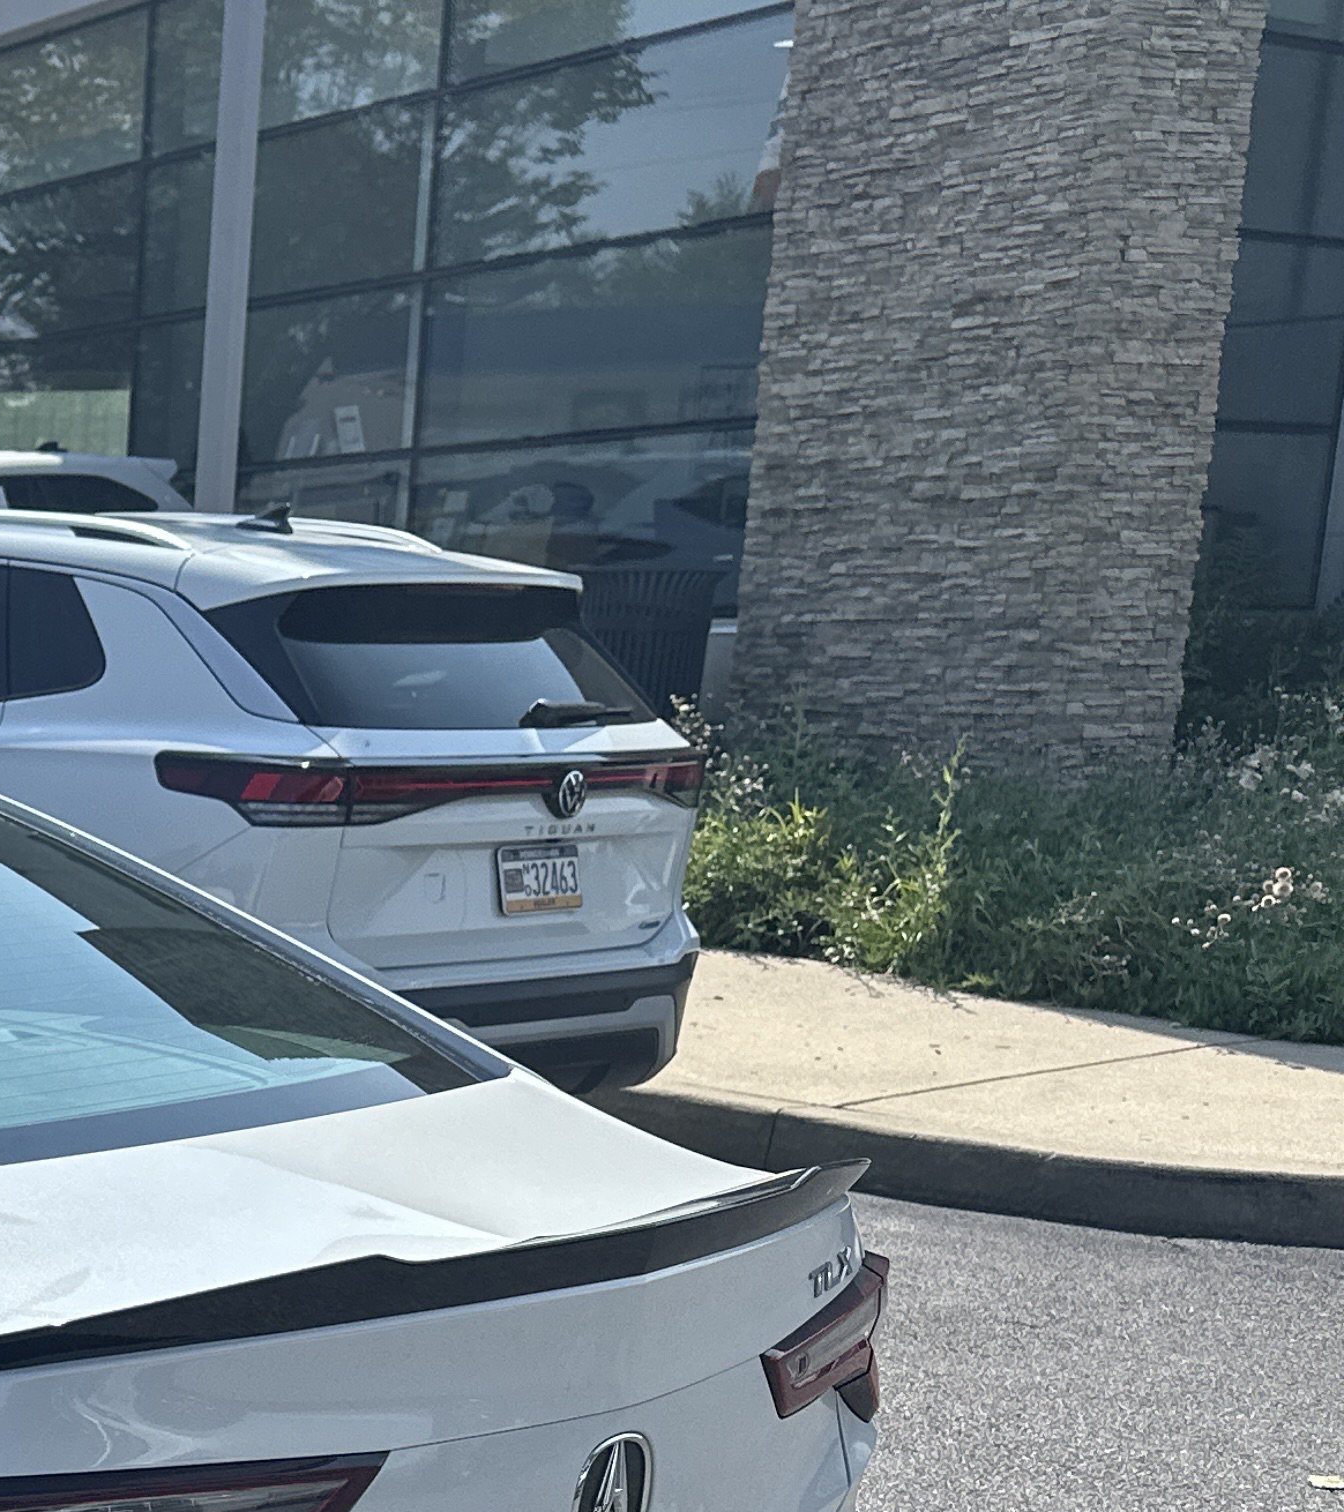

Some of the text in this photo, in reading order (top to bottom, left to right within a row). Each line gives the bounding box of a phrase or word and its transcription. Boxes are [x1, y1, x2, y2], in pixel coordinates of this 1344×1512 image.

[524, 823, 596, 836] TIGUAN
[530, 860, 579, 897] 32463
[808, 1245, 853, 1298] TLX
